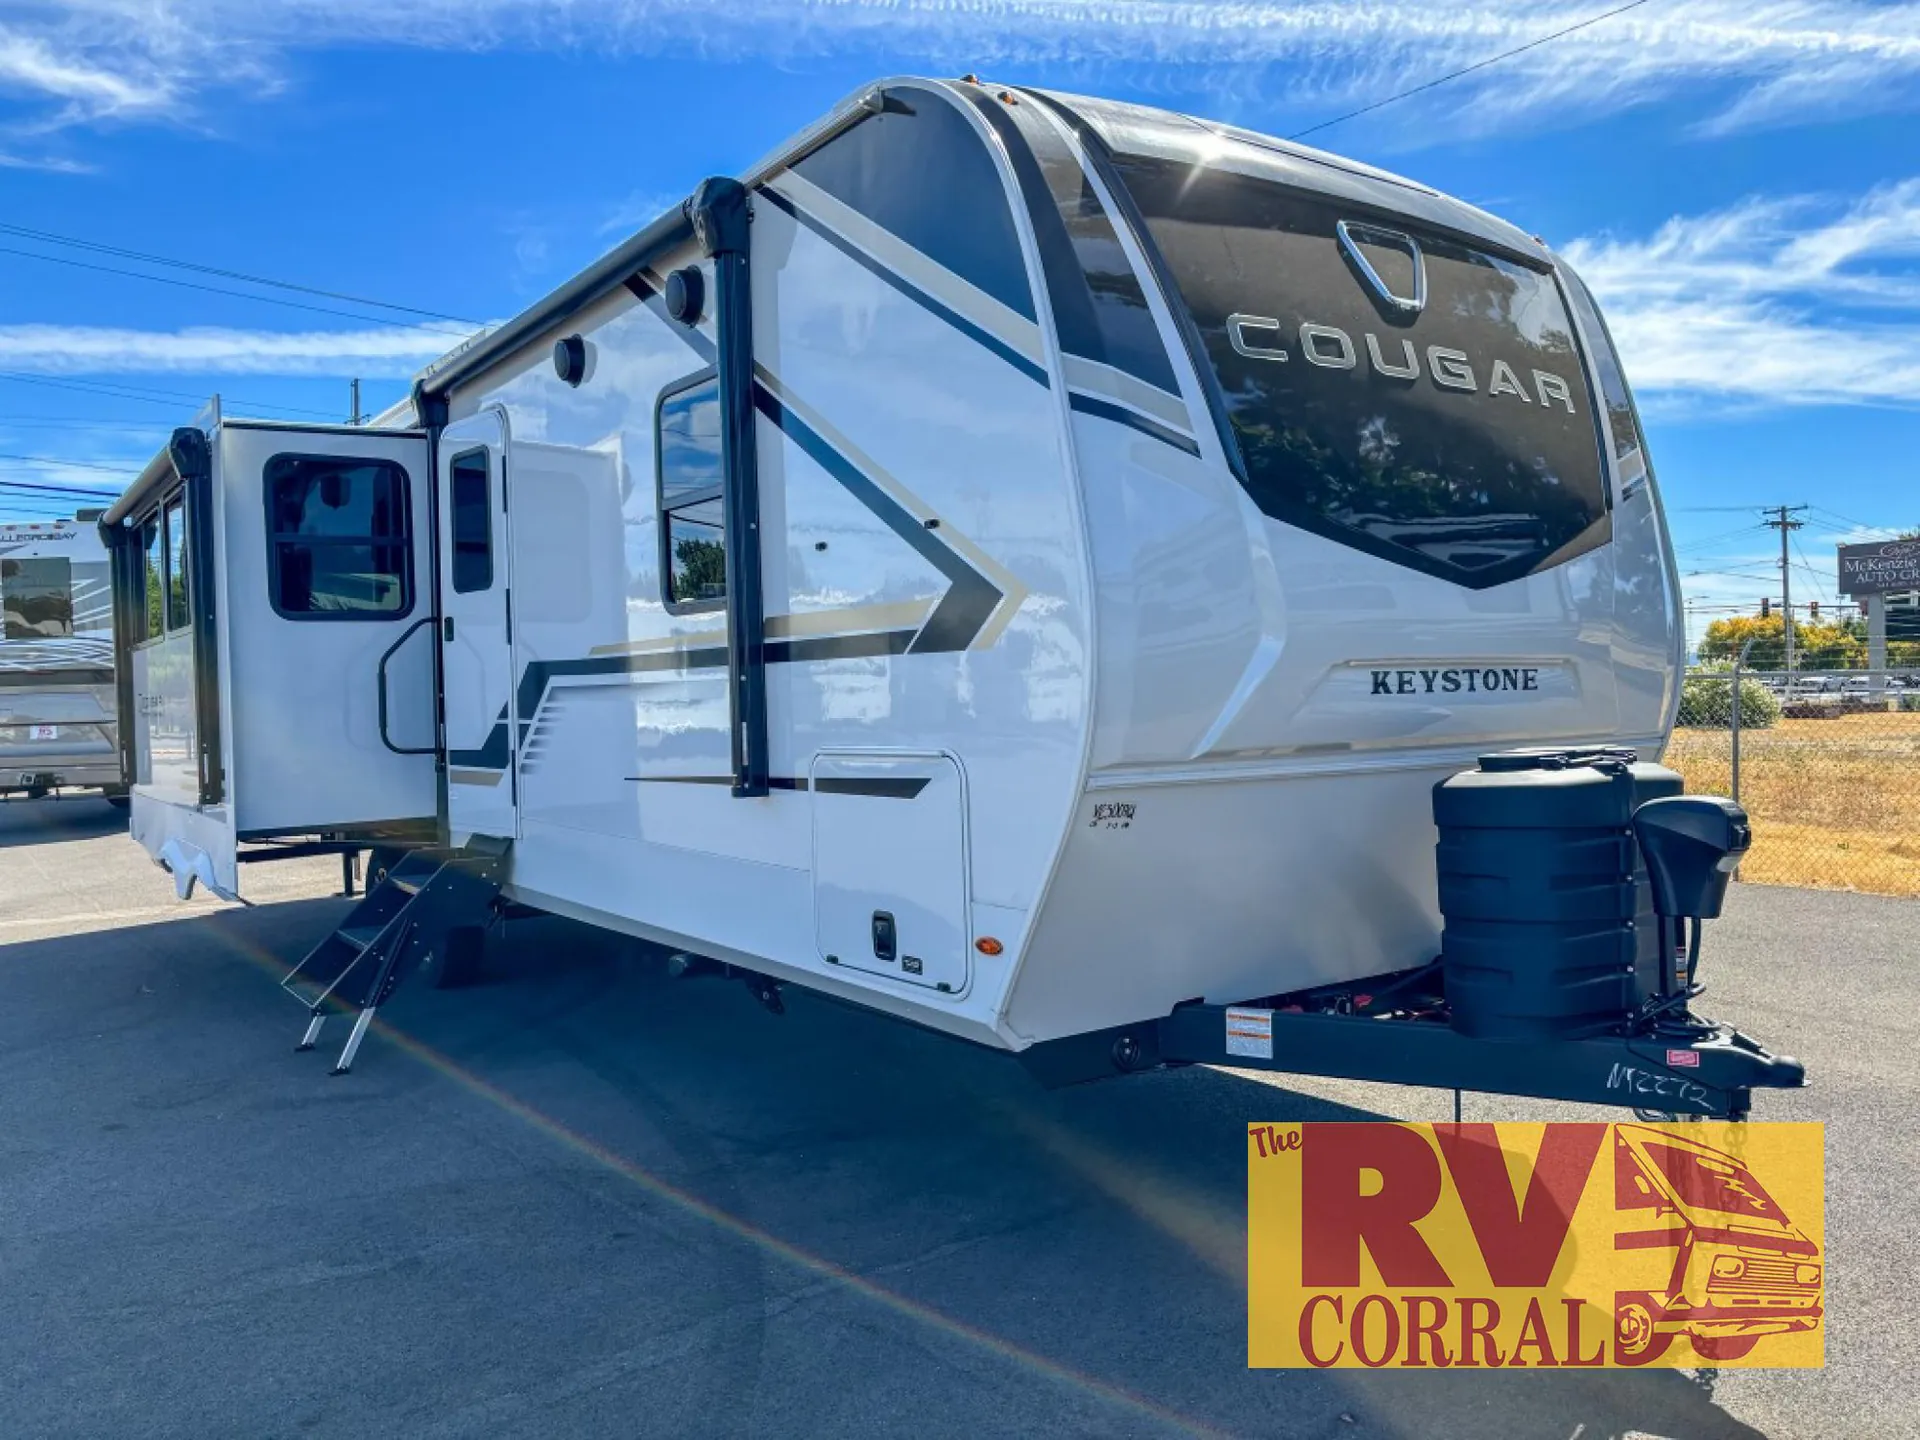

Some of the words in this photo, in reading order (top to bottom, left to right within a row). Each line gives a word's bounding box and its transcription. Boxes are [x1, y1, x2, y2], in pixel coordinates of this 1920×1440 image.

[1226, 313, 1576, 414] COUGAR
[1844, 556, 1917, 573] McKenzie
[1855, 570, 1897, 584] AUTO
[1899, 567, 1920, 581] GR
[1370, 668, 1539, 695] KEYSTONE
